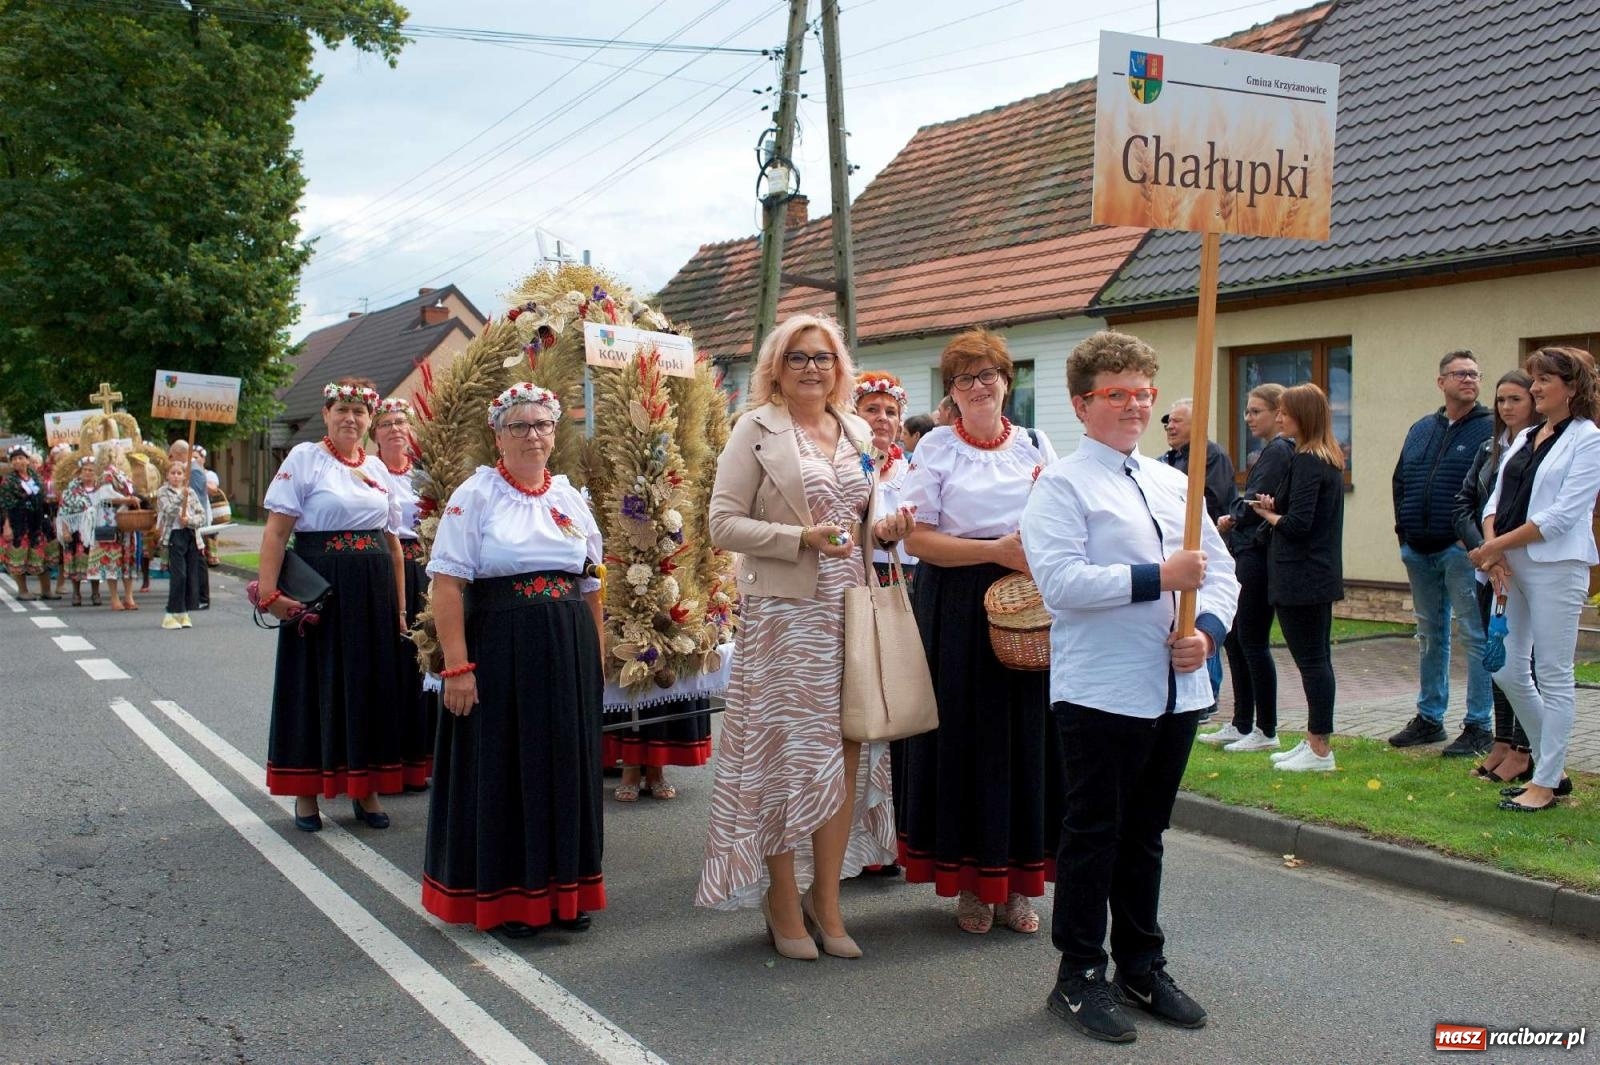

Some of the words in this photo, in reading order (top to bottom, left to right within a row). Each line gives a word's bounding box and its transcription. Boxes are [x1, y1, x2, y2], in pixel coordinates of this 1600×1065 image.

[1246, 75, 1272, 88] Gmina
[1274, 79, 1328, 95] Krzyżanowice
[1121, 134, 1309, 208] Chałupki
[599, 348, 628, 362] KGW
[157, 395, 234, 413] Bieńkowice
